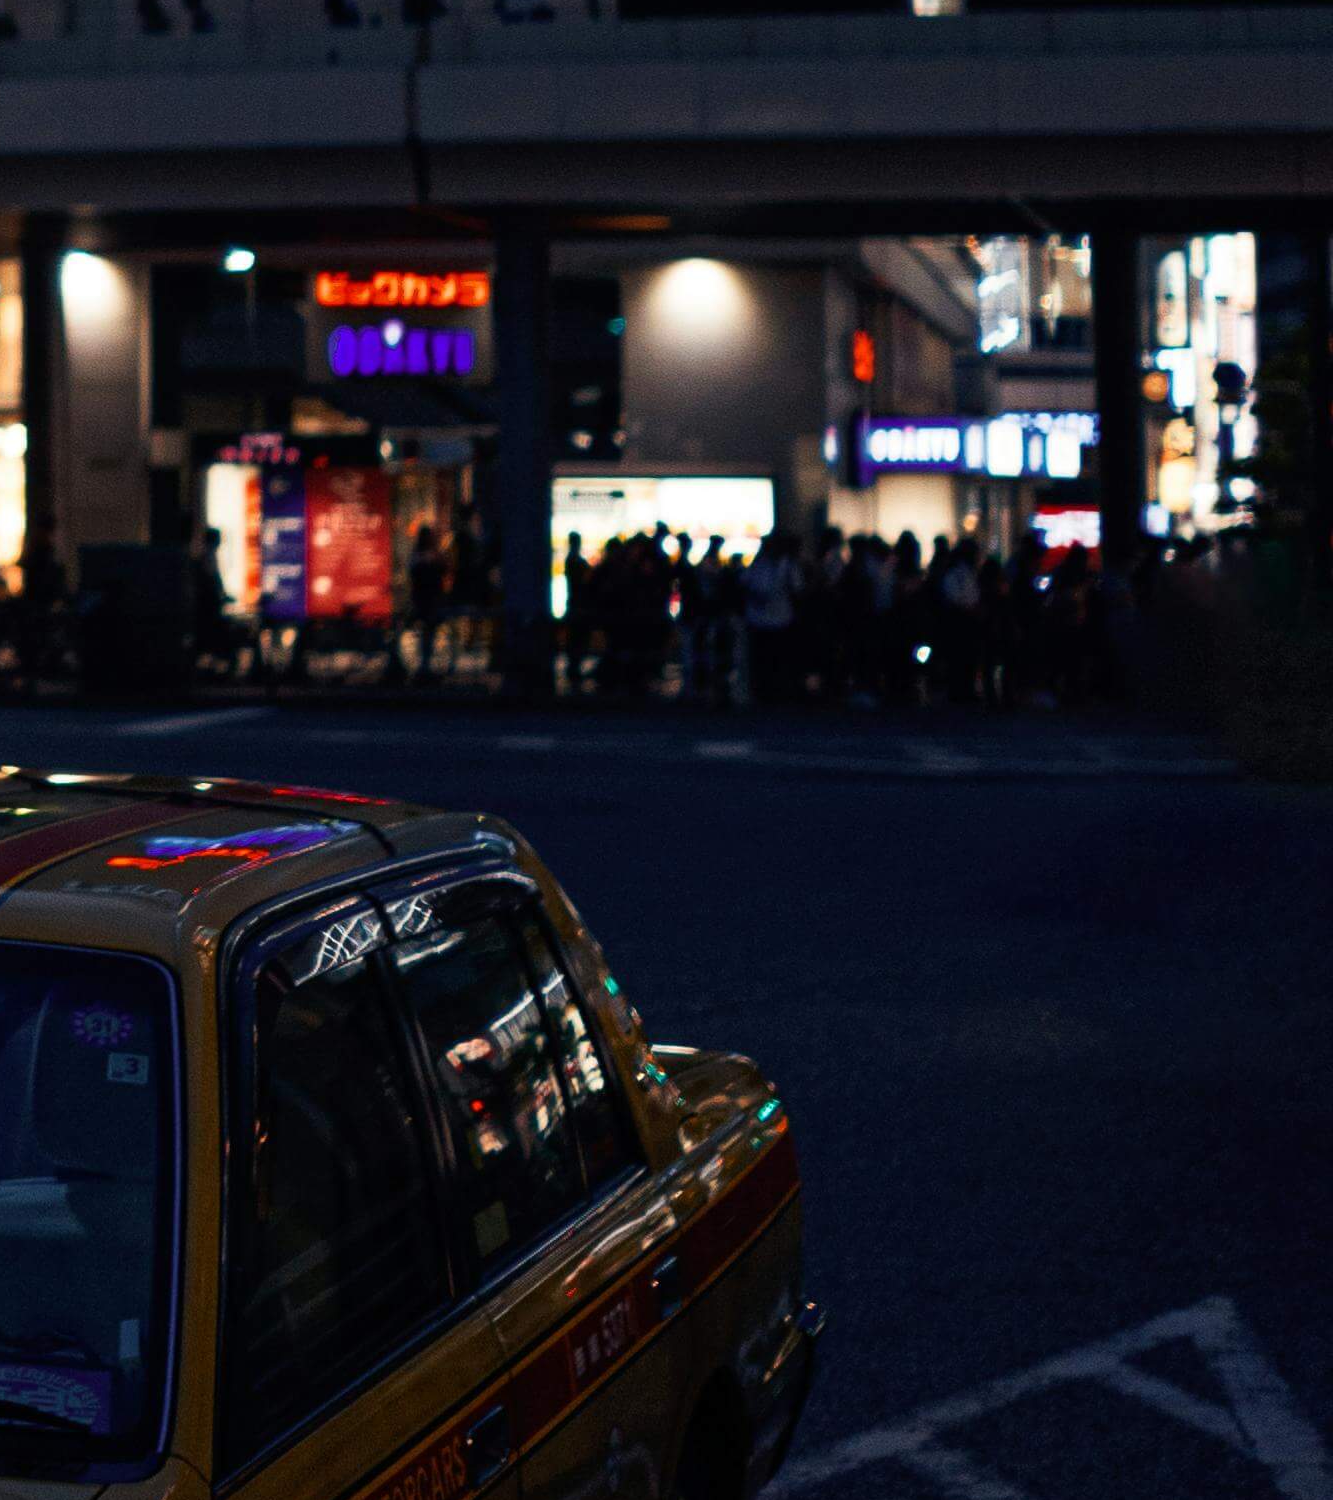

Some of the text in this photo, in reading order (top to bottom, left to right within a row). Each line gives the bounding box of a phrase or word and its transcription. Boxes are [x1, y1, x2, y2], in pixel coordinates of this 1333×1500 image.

[314, 270, 493, 309] ビックカメラ
